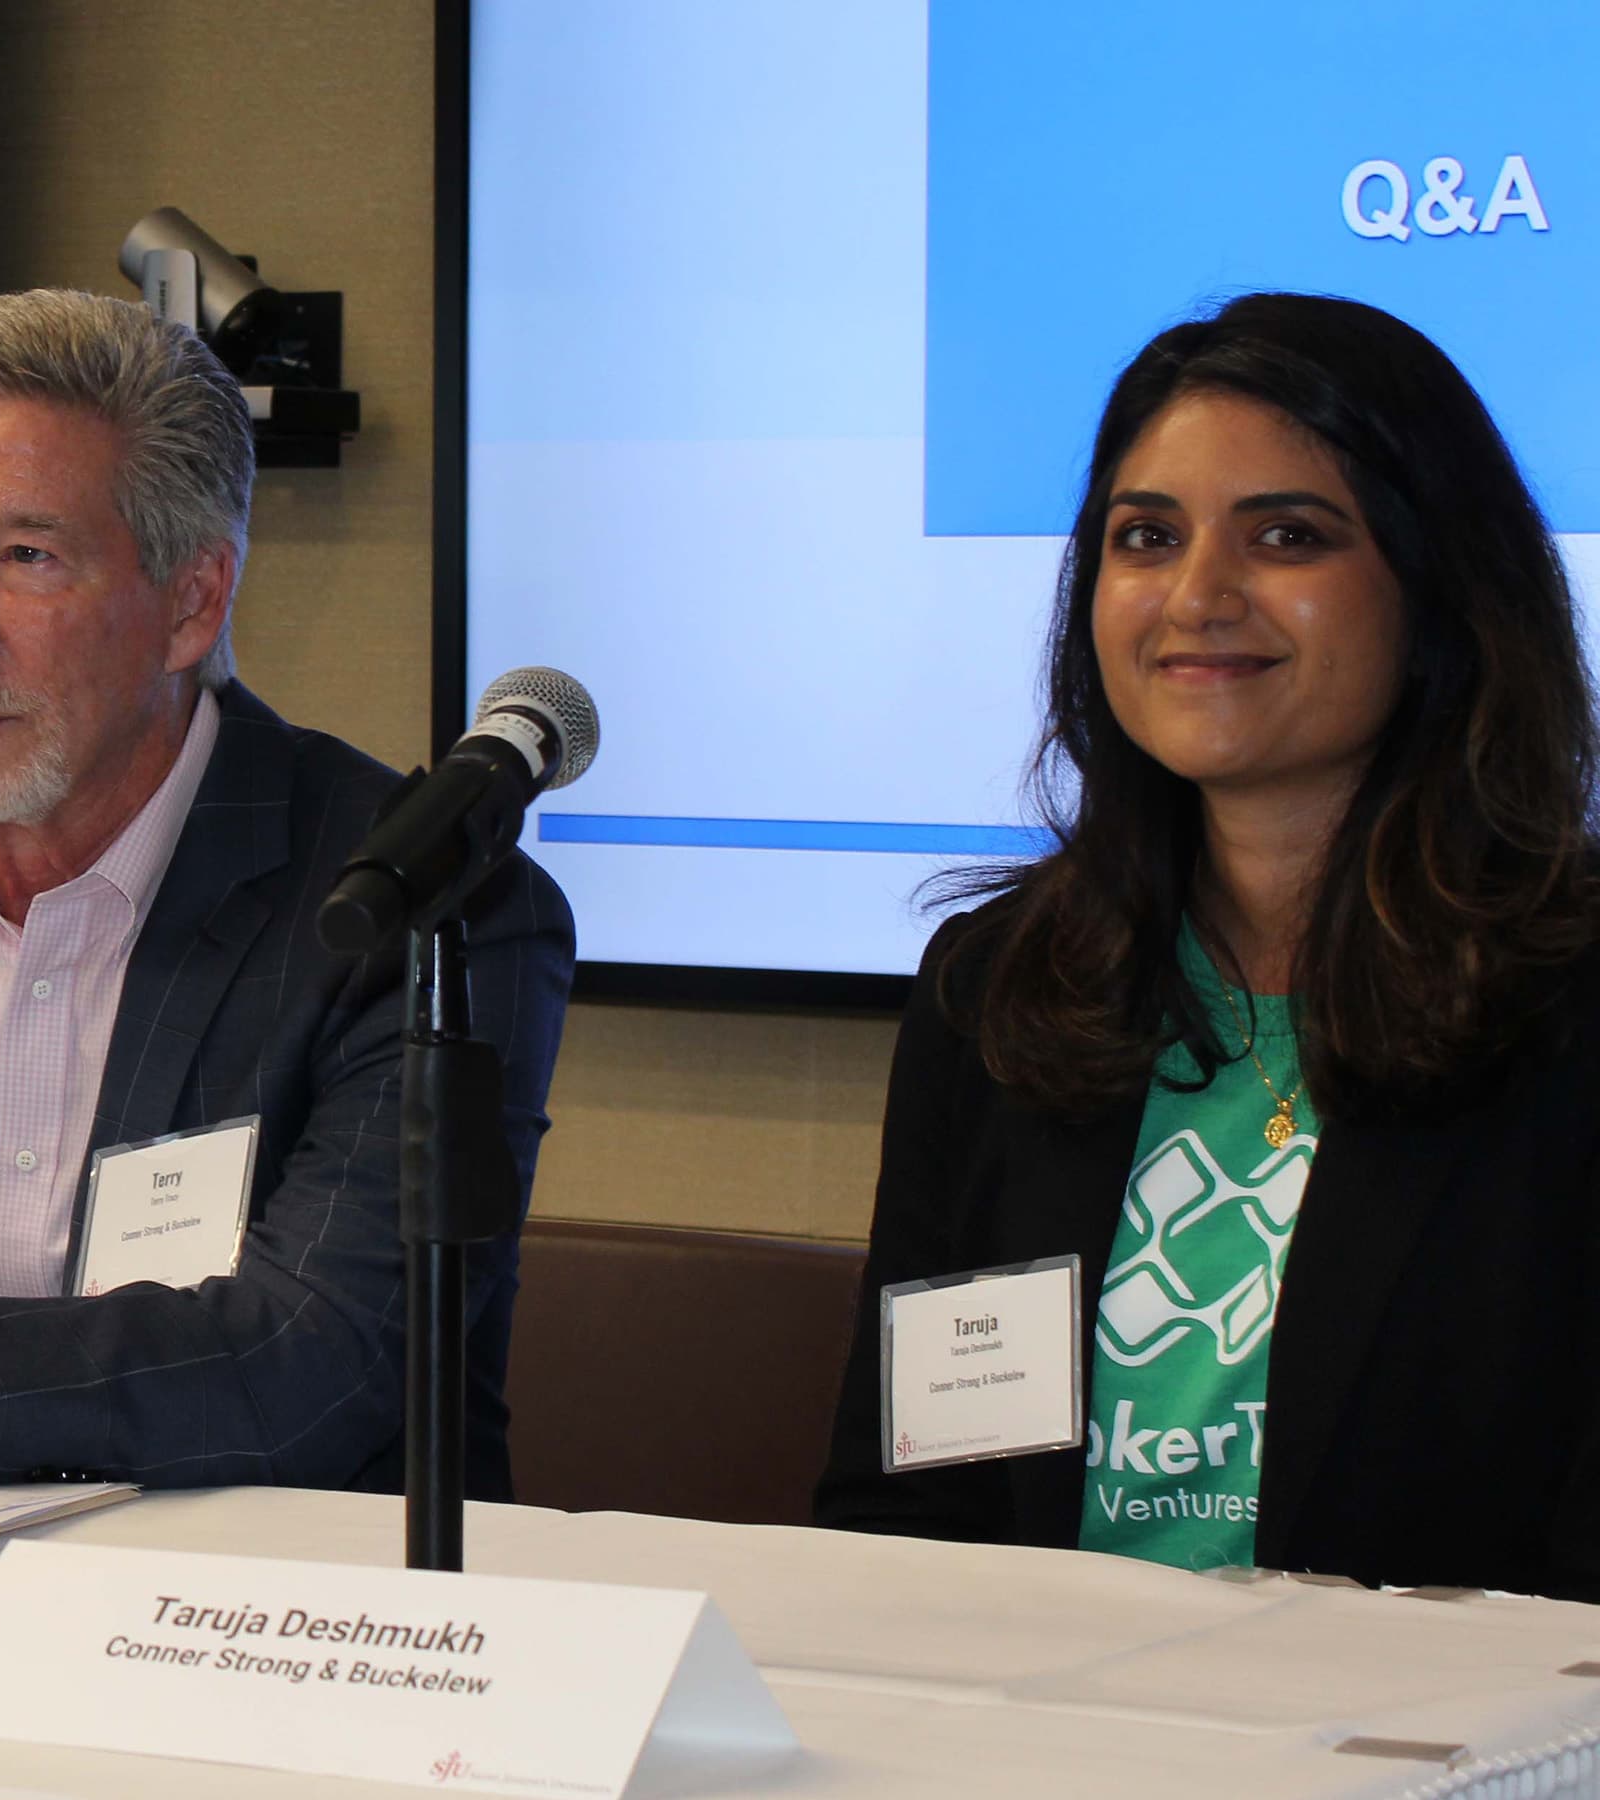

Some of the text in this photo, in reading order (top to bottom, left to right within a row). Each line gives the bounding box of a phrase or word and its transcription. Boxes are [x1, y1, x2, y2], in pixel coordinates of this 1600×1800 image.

[1341, 153, 1551, 243] Q&A
[152, 1170, 183, 1190] Terry
[143, 1225, 164, 1238] Strong
[954, 1313, 999, 1337] Taruja
[929, 1369, 1027, 1394] Conner Strong & Buckelew
[1097, 1483, 1259, 1523] Ventures
[152, 1596, 486, 1656] Taruja Deshmukh
[105, 1635, 493, 1696] Conner Strong & Buckelew
